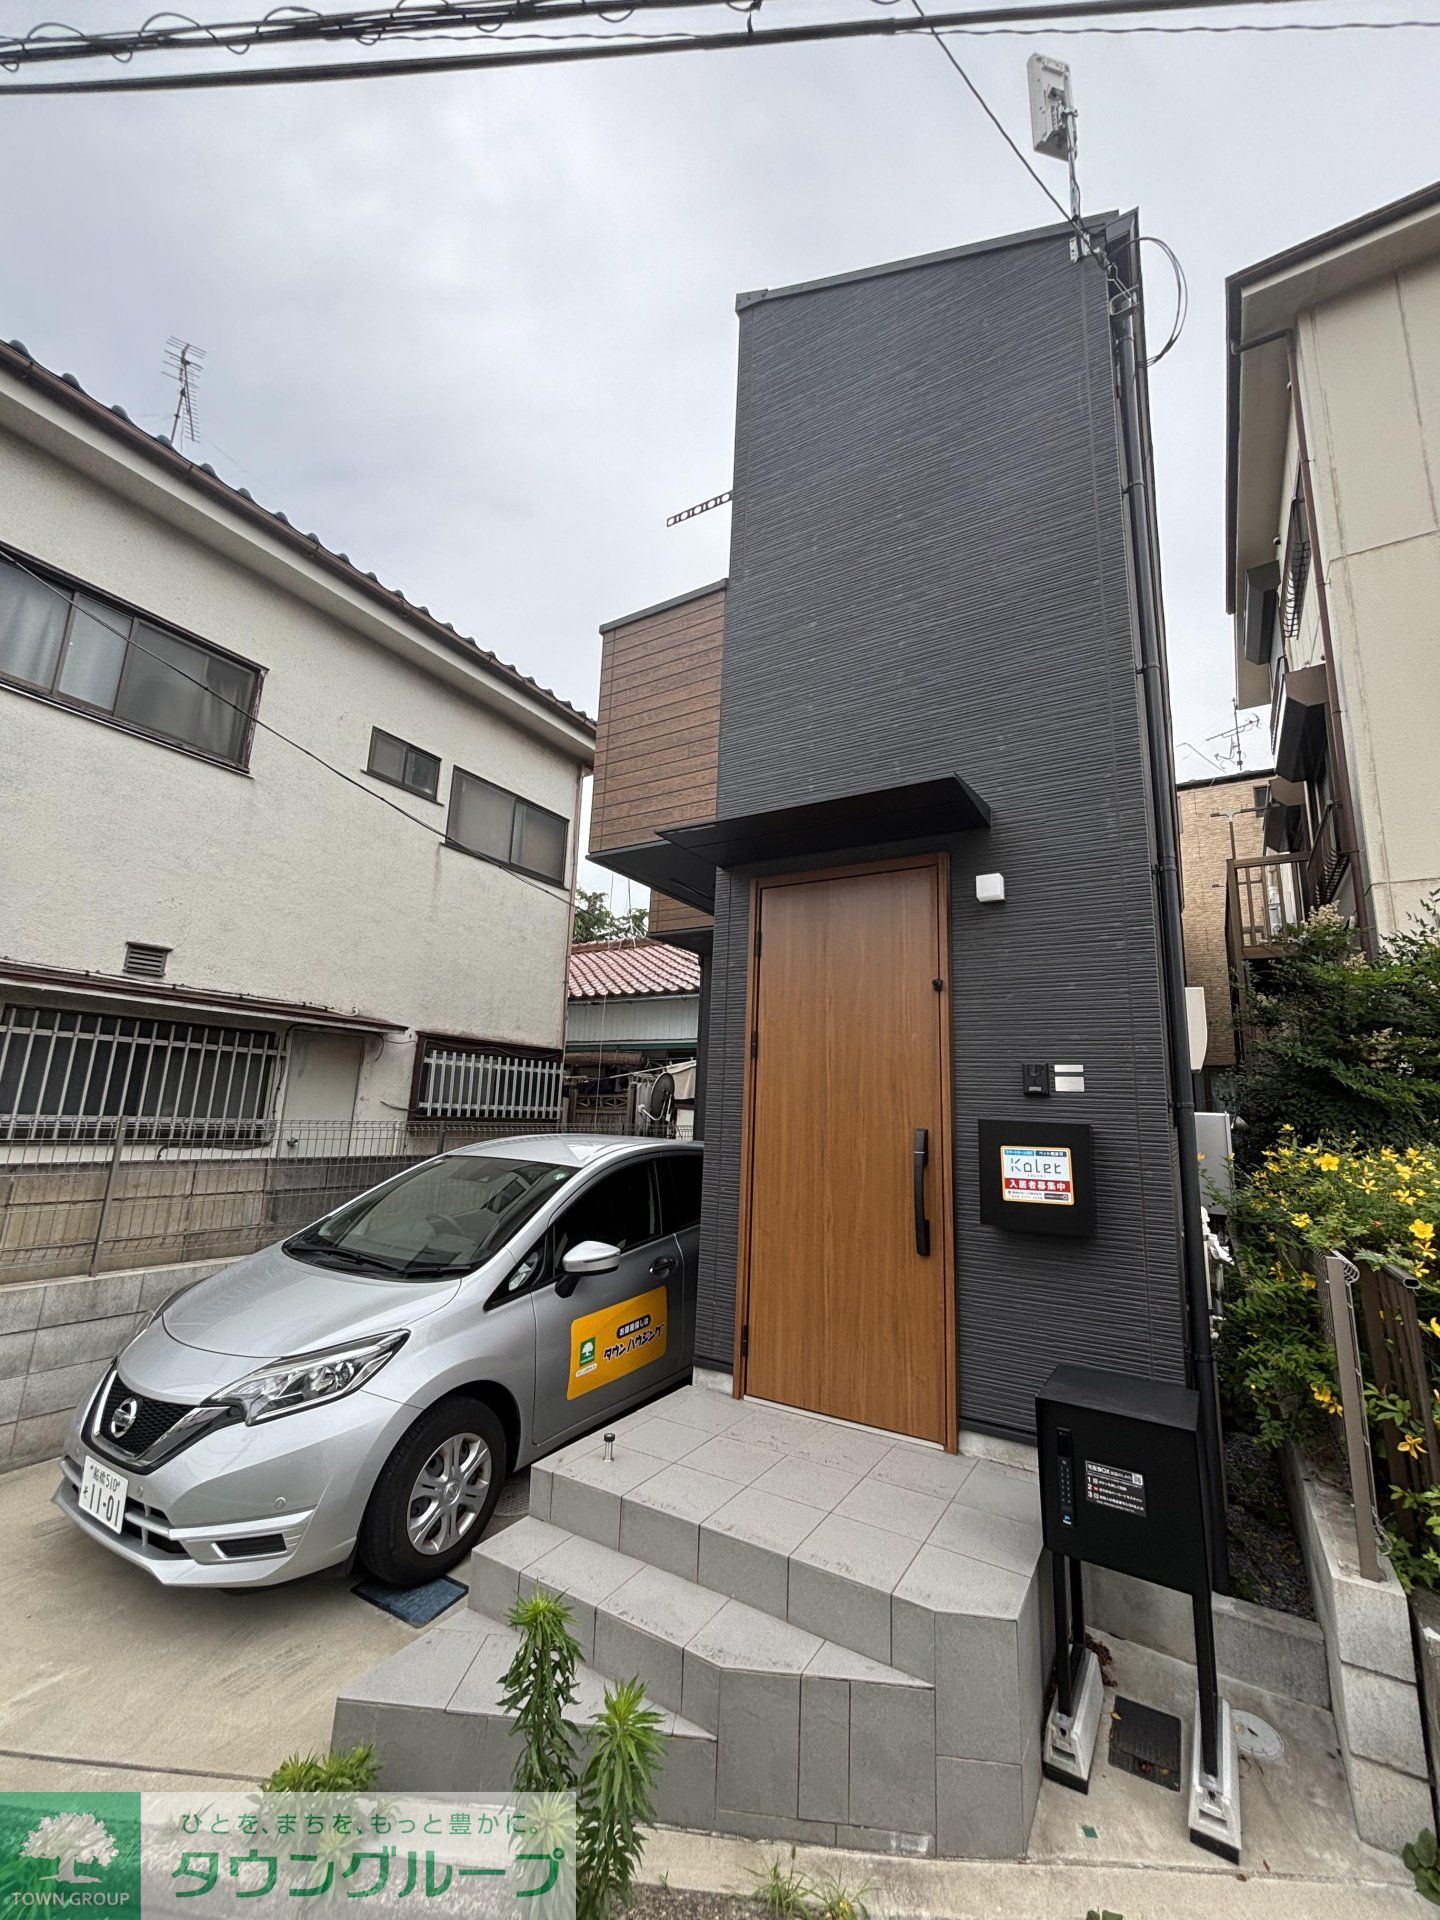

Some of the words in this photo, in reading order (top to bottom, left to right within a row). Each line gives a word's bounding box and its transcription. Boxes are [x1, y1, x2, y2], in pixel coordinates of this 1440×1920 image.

[1011, 1158, 1062, 1174] Kolet
[1009, 1179, 1066, 1191] 入居者募集中
[604, 1324, 664, 1361] タウンハウジング
[89, 1483, 120, 1527] 11-01
